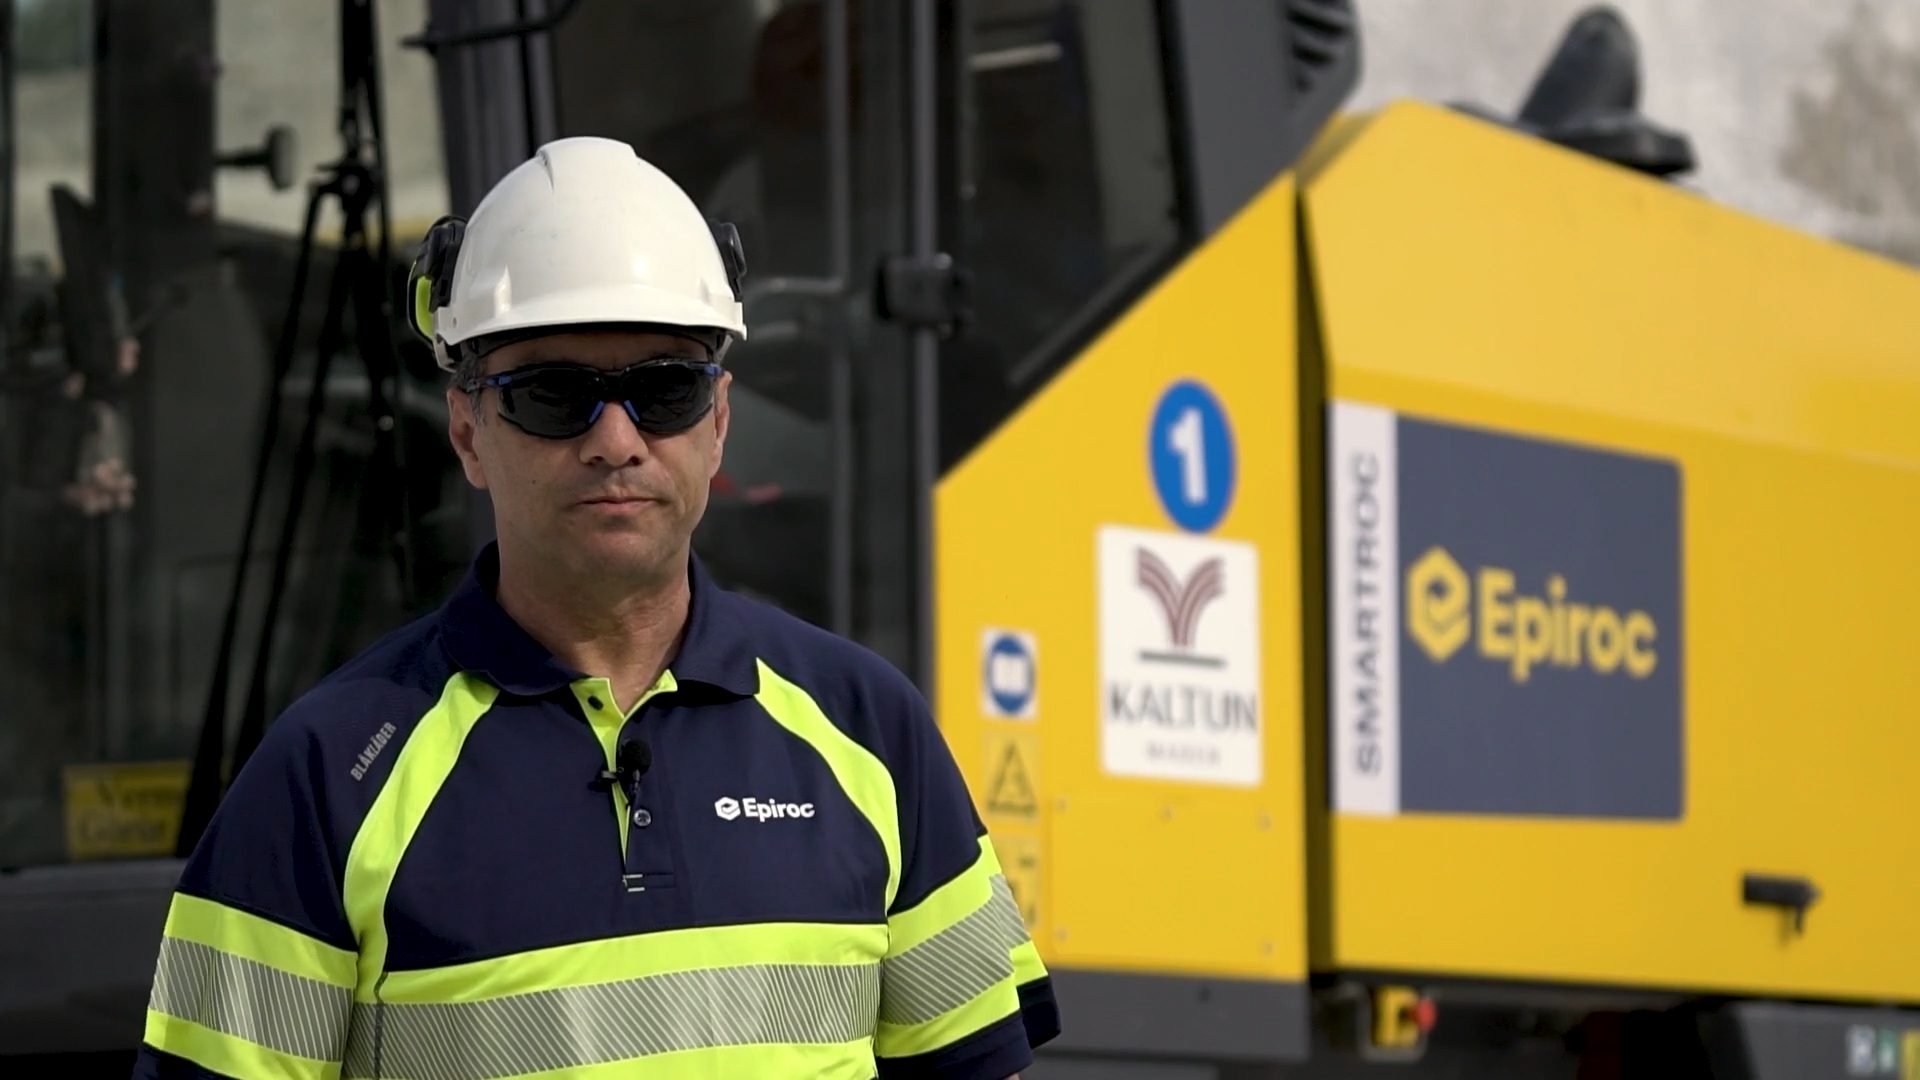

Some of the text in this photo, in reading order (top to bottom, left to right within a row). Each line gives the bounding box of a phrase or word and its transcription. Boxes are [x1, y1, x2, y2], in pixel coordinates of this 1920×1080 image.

[1167, 409, 1207, 504] 1
[1352, 451, 1381, 776] SMARTROC
[1477, 568, 1657, 682] Epiroc
[1108, 682, 1257, 733] KALTUN
[350, 721, 397, 781] BLÅKLÄDER
[743, 798, 815, 821] Epiroc
